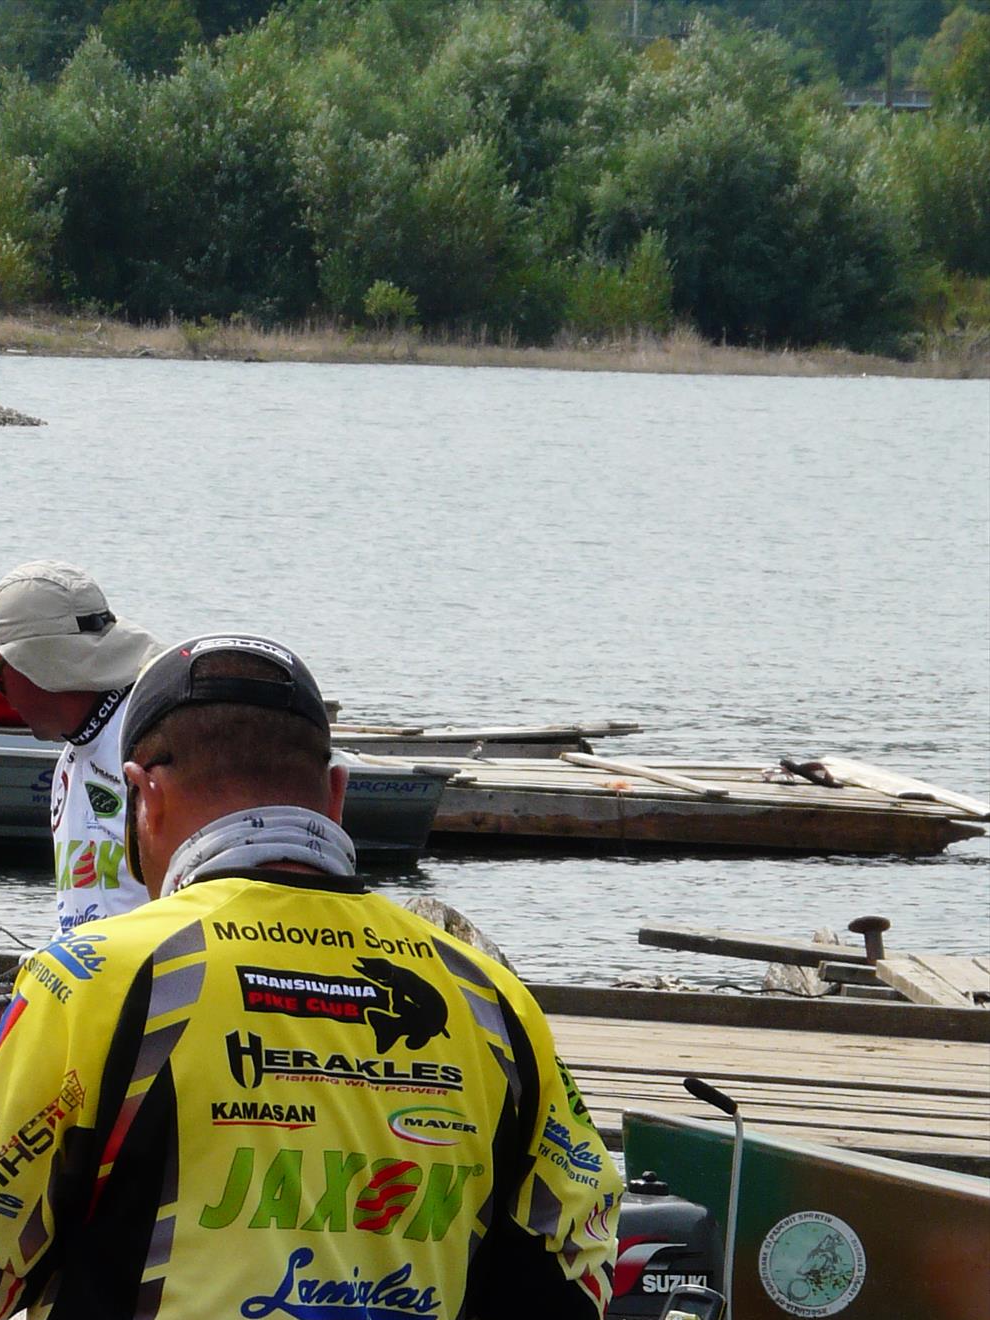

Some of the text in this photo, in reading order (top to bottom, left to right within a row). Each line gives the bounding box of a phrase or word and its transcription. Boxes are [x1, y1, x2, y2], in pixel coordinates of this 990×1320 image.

[212, 921, 434, 958] Moldovan Sorin
[243, 973, 377, 998] TRANSILVANIA
[247, 991, 359, 1017] PIKE CLUB
[224, 1029, 464, 1089] HERAKLES
[274, 1073, 340, 1086] FISHING
[384, 1084, 449, 1097] POWER
[211, 1102, 316, 1123] KAMASAN
[404, 1116, 478, 1135] MAVER
[198, 1147, 474, 1242] JAXON
[642, 1274, 707, 1293] SUZUKI
